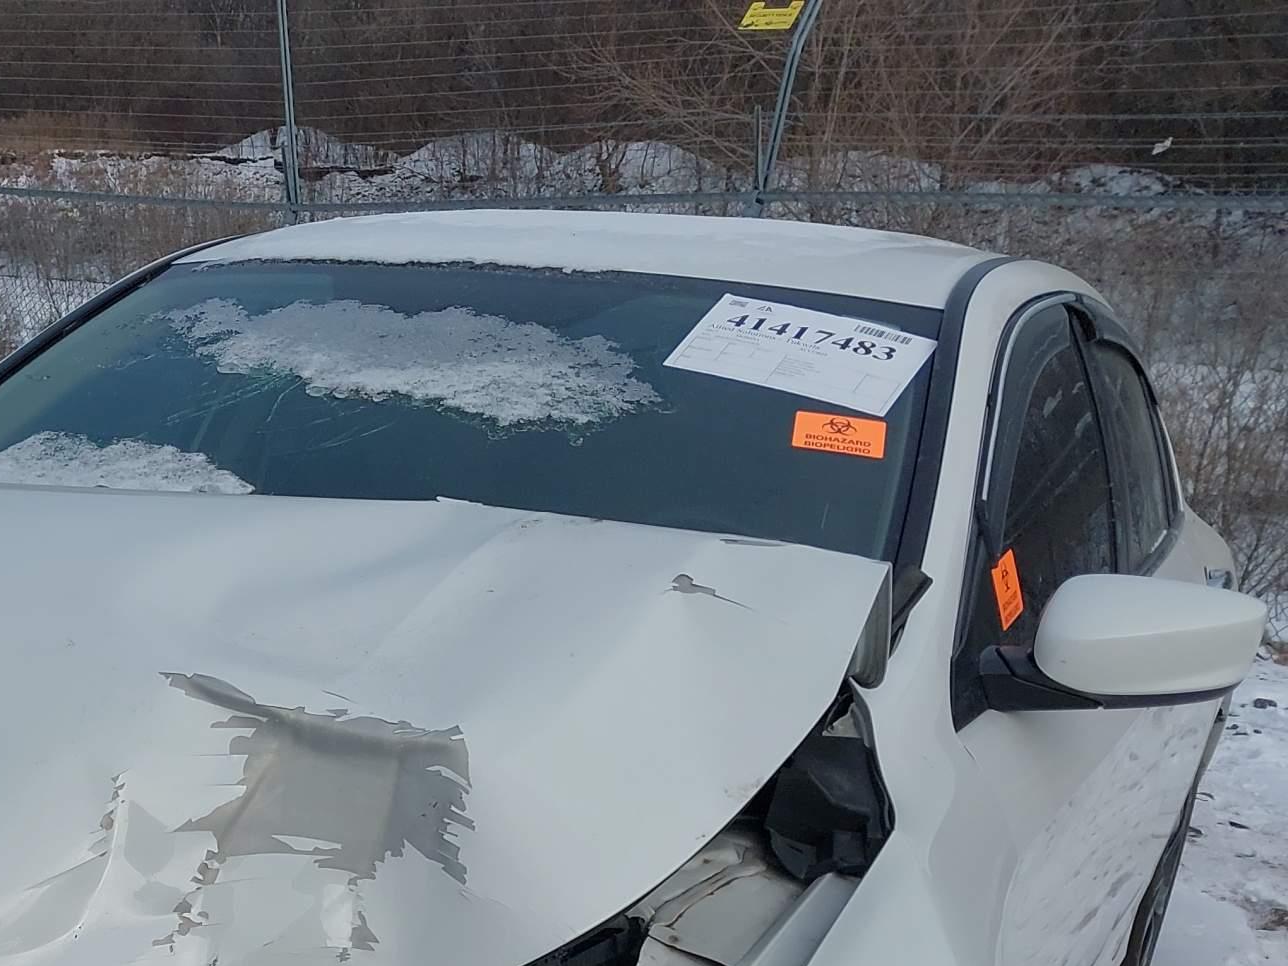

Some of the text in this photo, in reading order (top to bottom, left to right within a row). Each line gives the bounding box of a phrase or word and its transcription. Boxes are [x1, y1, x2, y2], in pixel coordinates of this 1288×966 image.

[726, 314, 897, 361] 41417483
[805, 433, 871, 447] BIOHAZARD
[804, 441, 871, 454] BIOPELIGRO
